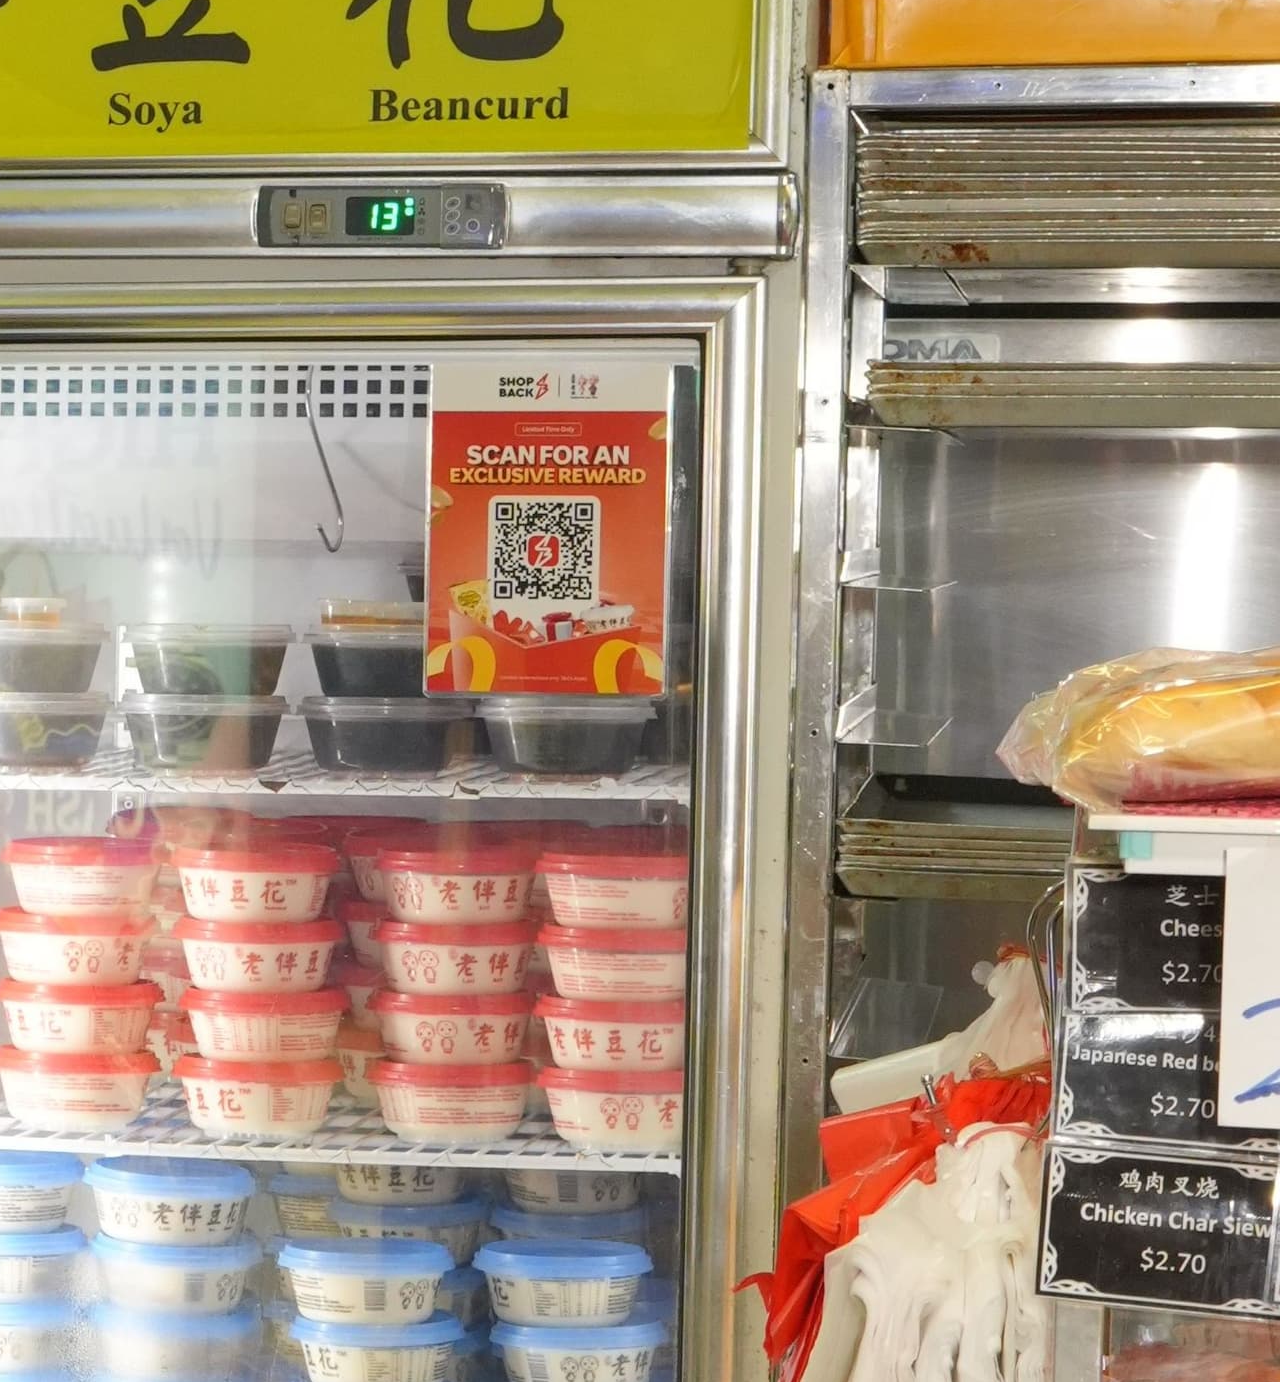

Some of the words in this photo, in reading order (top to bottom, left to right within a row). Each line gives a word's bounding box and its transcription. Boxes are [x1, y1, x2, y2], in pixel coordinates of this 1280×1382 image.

[107, 93, 203, 132] Soya
[369, 87, 569, 124] Beancurd
[499, 377, 534, 387] SHOP
[499, 388, 534, 398] BACK
[466, 445, 538, 466] SCAN
[539, 445, 590, 466] FOR
[592, 445, 630, 466] AN
[449, 468, 556, 485] EXCLUSIVE
[558, 468, 647, 485] REWARD
[1160, 919, 1222, 938] Chees
[1072, 1045, 1157, 1069] Japanese
[1162, 1052, 1197, 1071] Red
[1150, 1092, 1215, 1118] $2.70
[1080, 1202, 1162, 1228] Chicken
[1168, 1212, 1217, 1234] Char
[1222, 1215, 1272, 1239] Siew
[1140, 1247, 1207, 1275] $2.70
